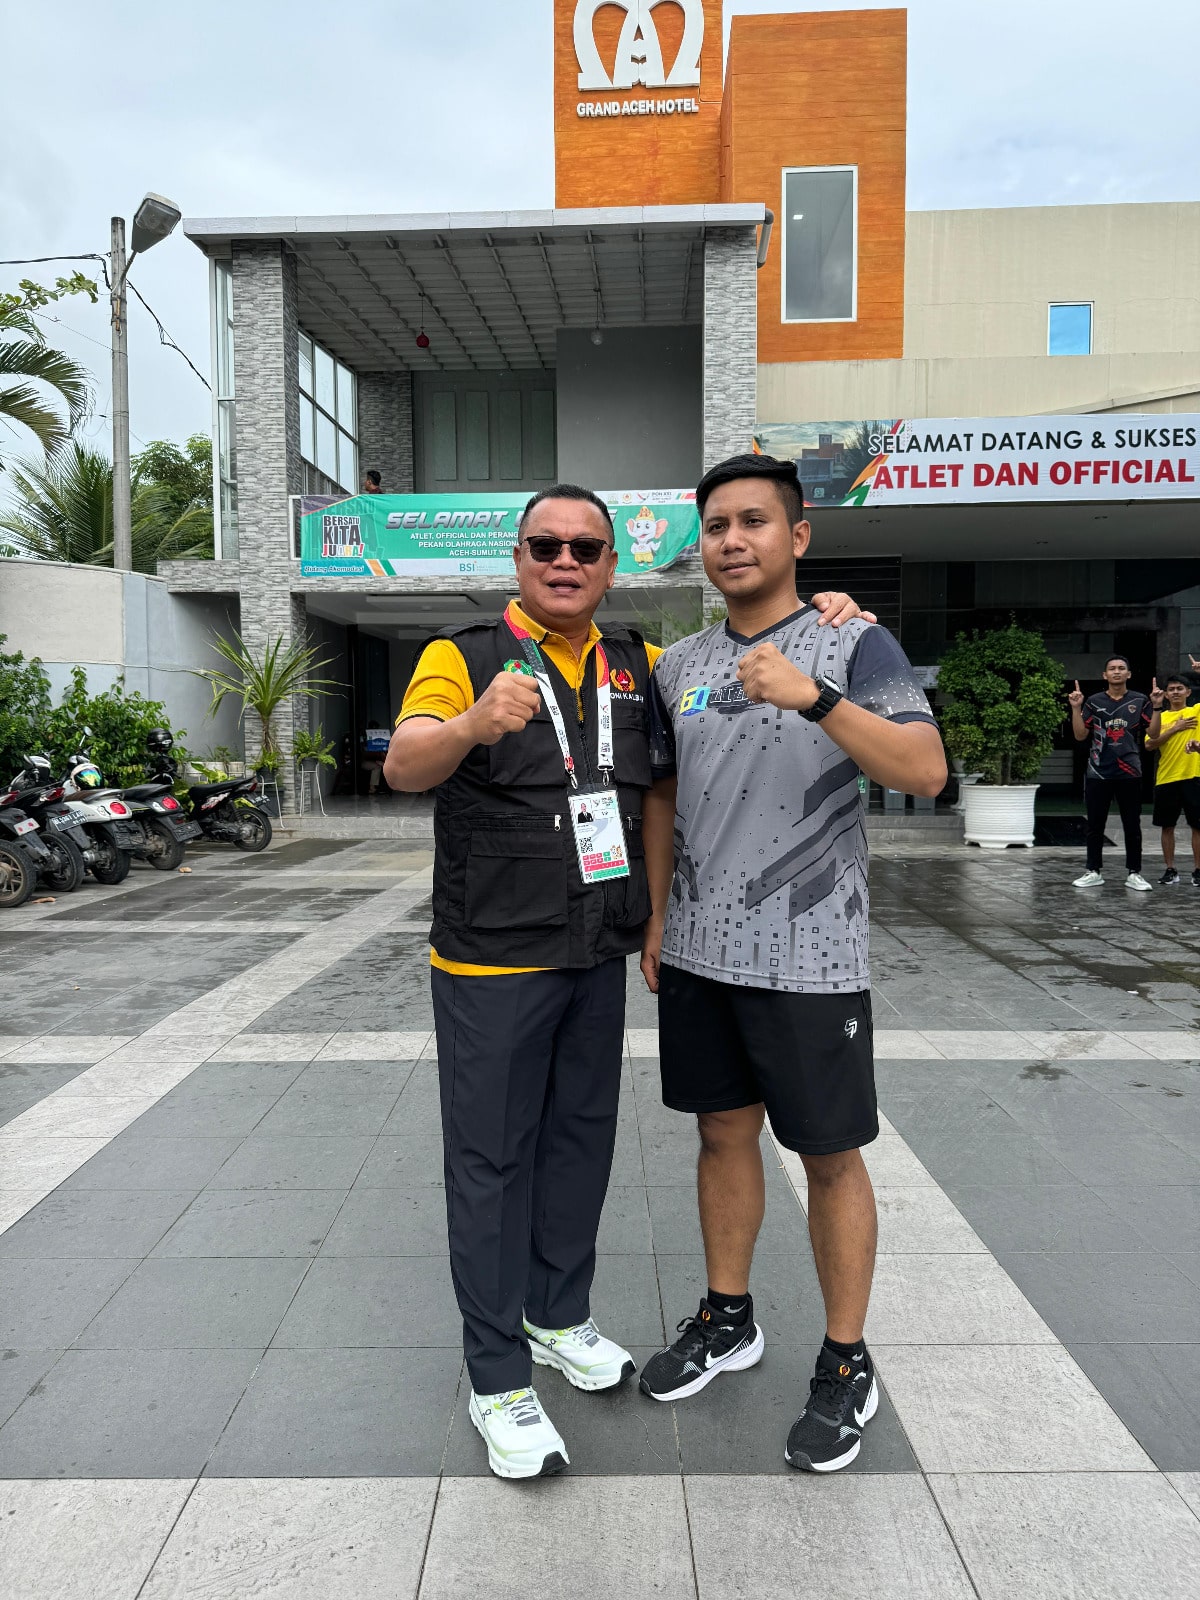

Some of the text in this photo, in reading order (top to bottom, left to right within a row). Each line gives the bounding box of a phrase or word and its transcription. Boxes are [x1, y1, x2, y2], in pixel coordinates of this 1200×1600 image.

[577, 98, 699, 117] GRAND ACEH HOTEL
[869, 427, 1197, 454] SELAMAT DATANG & SUKSES
[872, 458, 1195, 490] ATLET DAN OFFICIAL
[323, 515, 360, 526] BERSATU
[386, 511, 508, 529] SELAMAT
[323, 525, 361, 546] KITA
[410, 532, 434, 540] ATLET,
[436, 531, 468, 539] OFFICIAL
[322, 544, 364, 557] JUARA!
[460, 563, 475, 572] BSI
